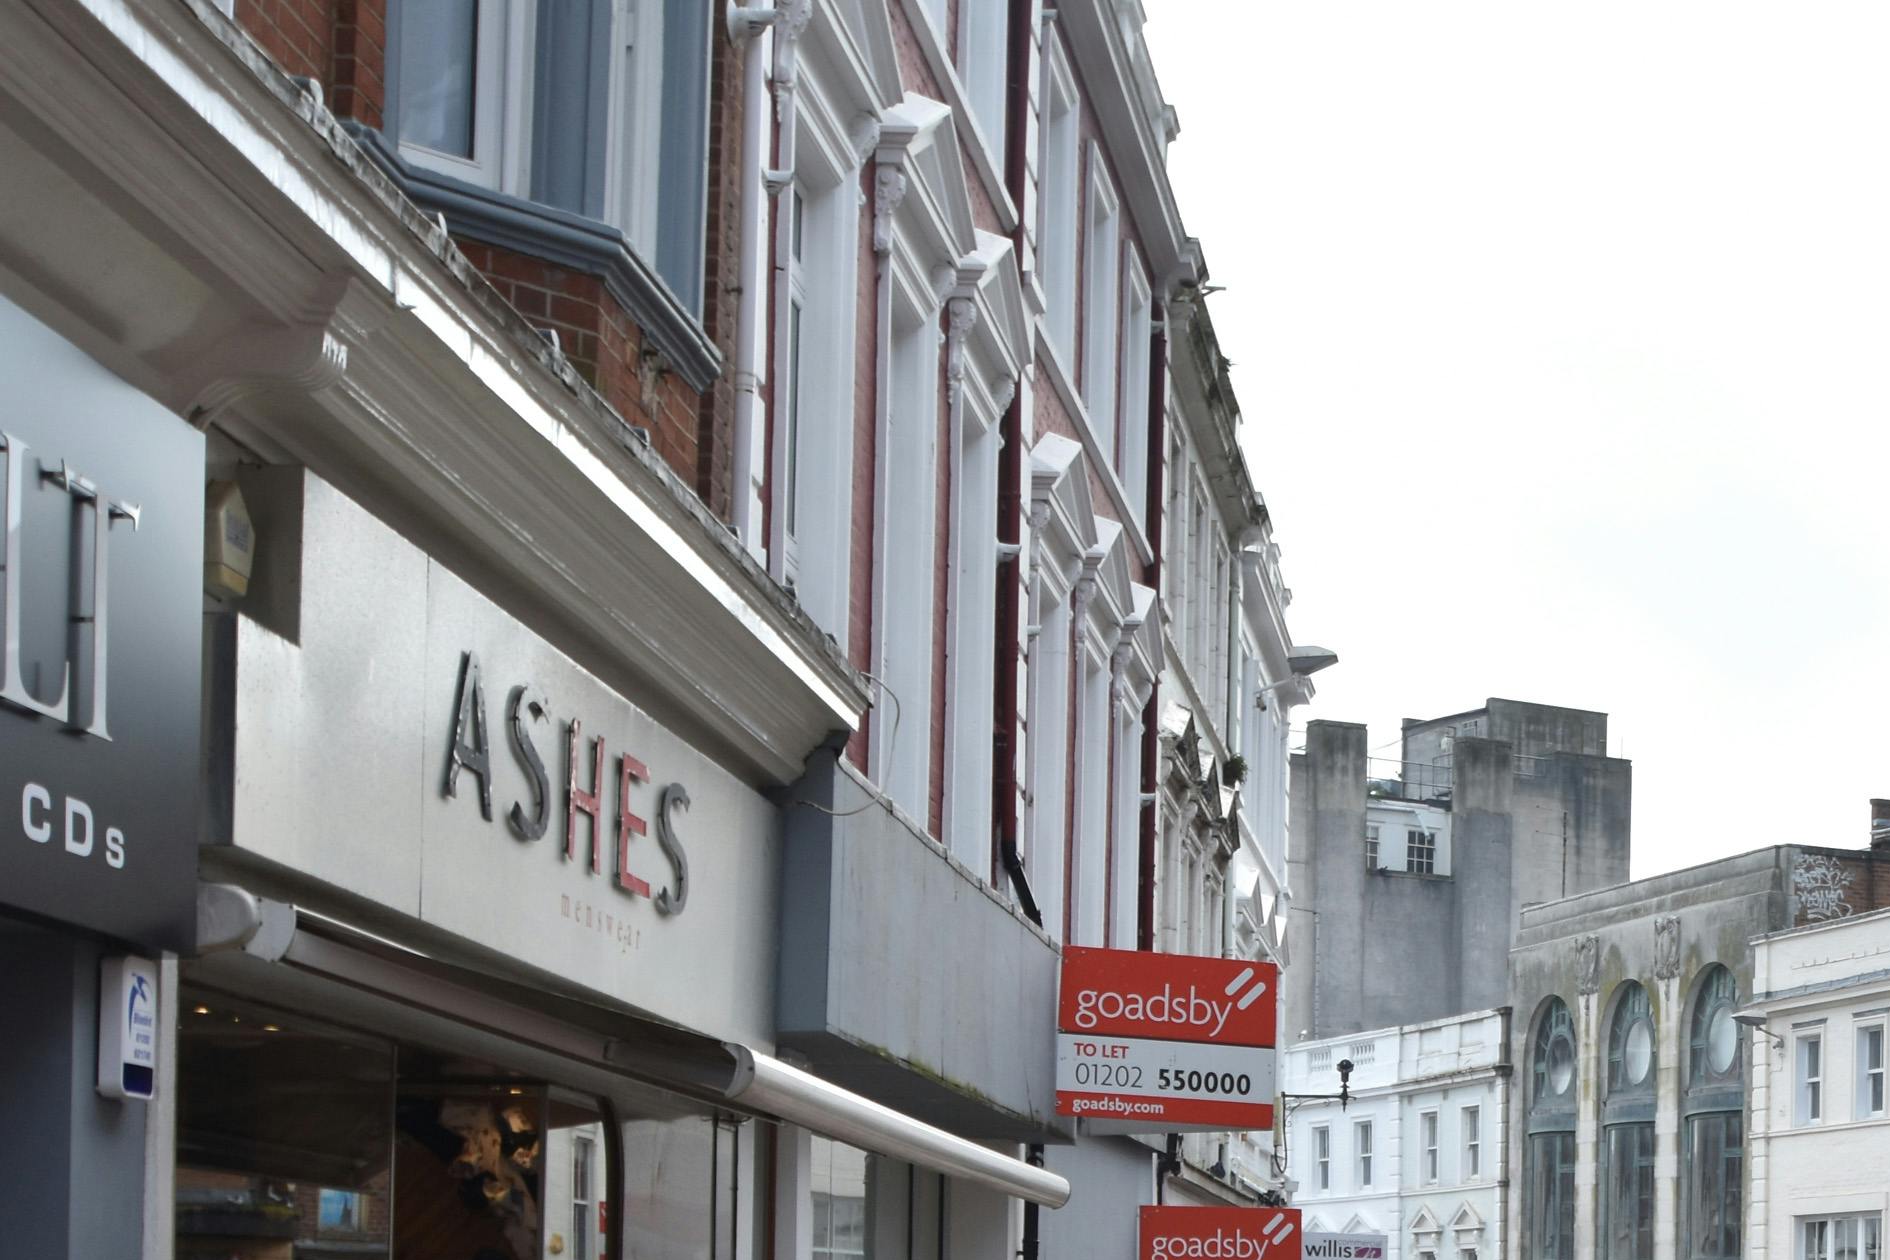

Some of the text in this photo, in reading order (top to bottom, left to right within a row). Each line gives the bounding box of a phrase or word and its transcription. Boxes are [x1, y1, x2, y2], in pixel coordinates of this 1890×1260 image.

[445, 650, 691, 916] ASHES
[22, 783, 126, 869] CDs
[1074, 983, 1233, 1038] goadsby
[1074, 1042, 1129, 1060] TO LET
[1075, 1062, 1251, 1096] 01202 550000
[1071, 1097, 1165, 1115] goadsby.com
[1304, 1239, 1353, 1259] willis
